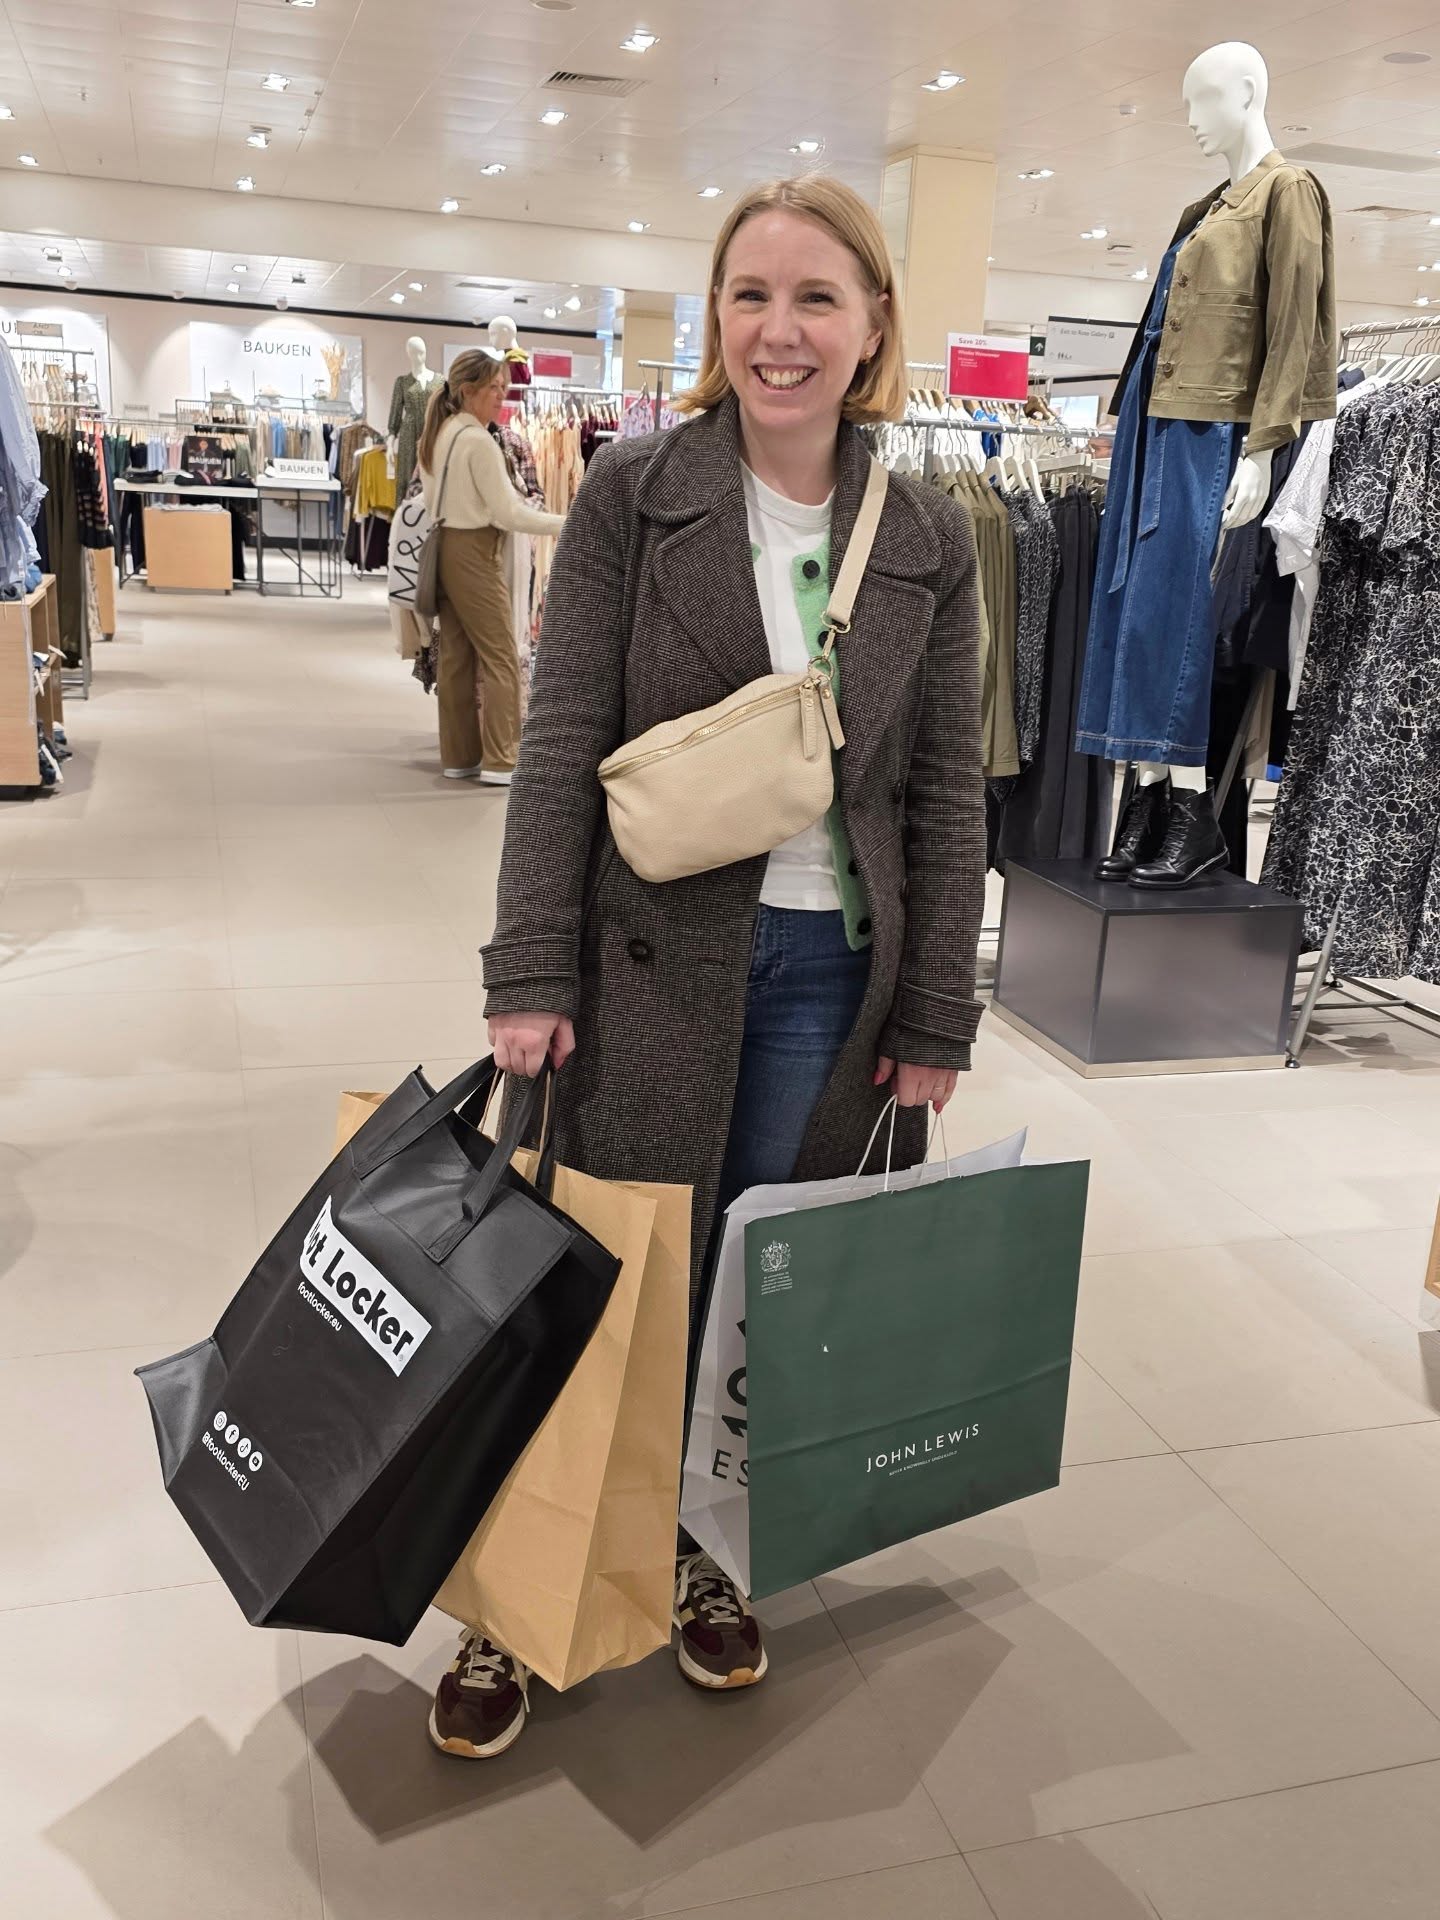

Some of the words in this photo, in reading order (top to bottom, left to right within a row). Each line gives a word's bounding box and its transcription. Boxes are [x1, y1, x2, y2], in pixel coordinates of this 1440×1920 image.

[243, 340, 311, 357] BAUKJEN
[958, 337, 973, 345] Save
[280, 464, 324, 475] BAUKJEN
[298, 1281, 343, 1332] footlocker.eu
[304, 1209, 327, 1268] ot
[322, 1248, 415, 1357] Locker
[202, 1430, 250, 1491] @footlockerEU
[866, 1443, 916, 1473] JOHN
[924, 1423, 979, 1453] LEWIS
